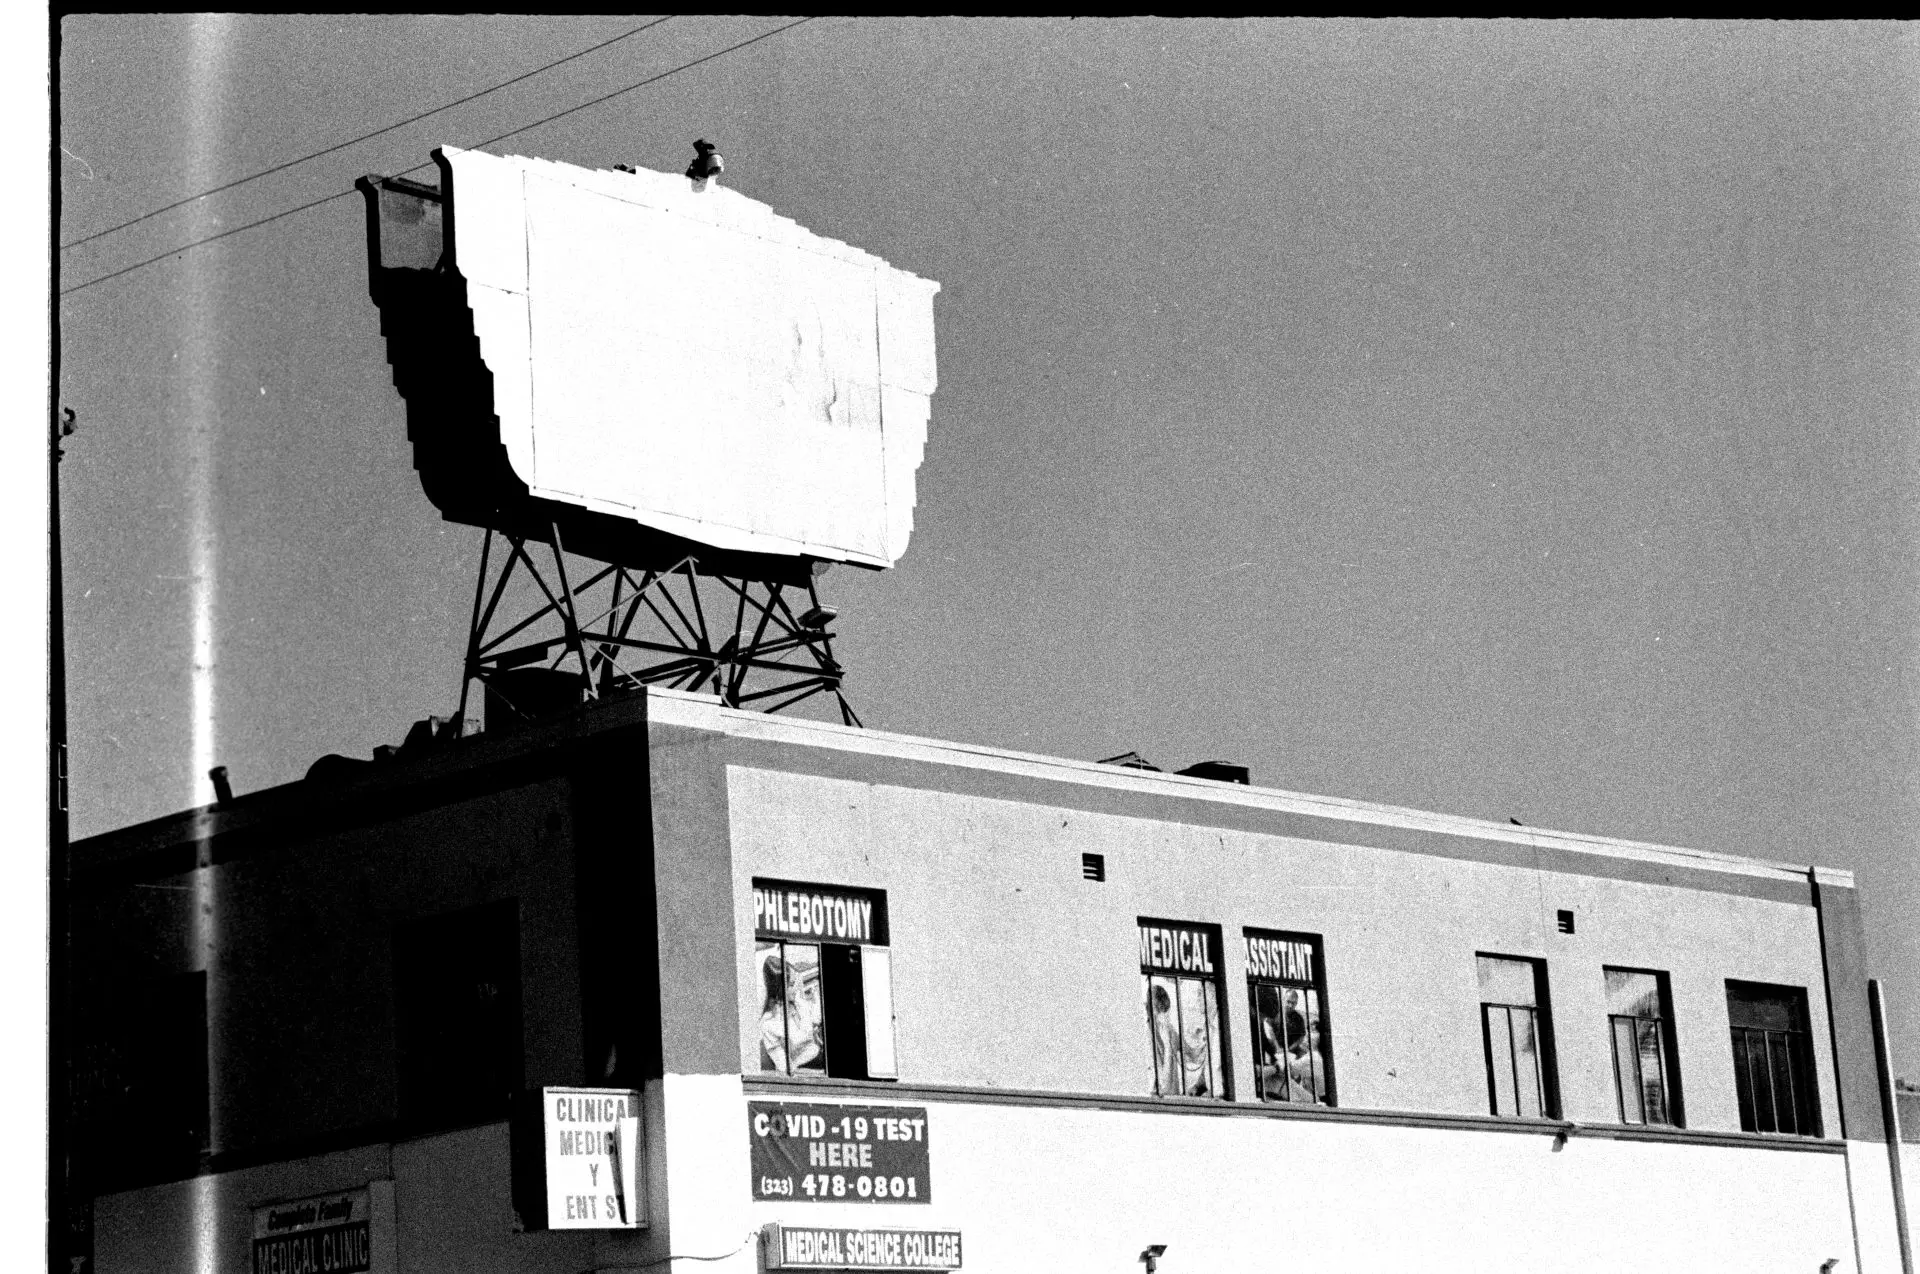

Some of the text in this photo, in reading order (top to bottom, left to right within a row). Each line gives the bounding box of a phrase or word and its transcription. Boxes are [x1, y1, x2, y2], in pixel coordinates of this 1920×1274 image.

[753, 888, 871, 939] PHLEBOTOMY
[1138, 926, 1213, 972] MEDICAL
[754, 1113, 924, 1142] COVID -19 TEST
[809, 1142, 873, 1168] HERE
[589, 1163, 599, 1187] Y
[761, 1174, 917, 1198] (323) 478-0801
[257, 1228, 368, 1274] MEDICAL CLINIC
[785, 1230, 960, 1266] MEDICAL SCIENCE COLLEGE
